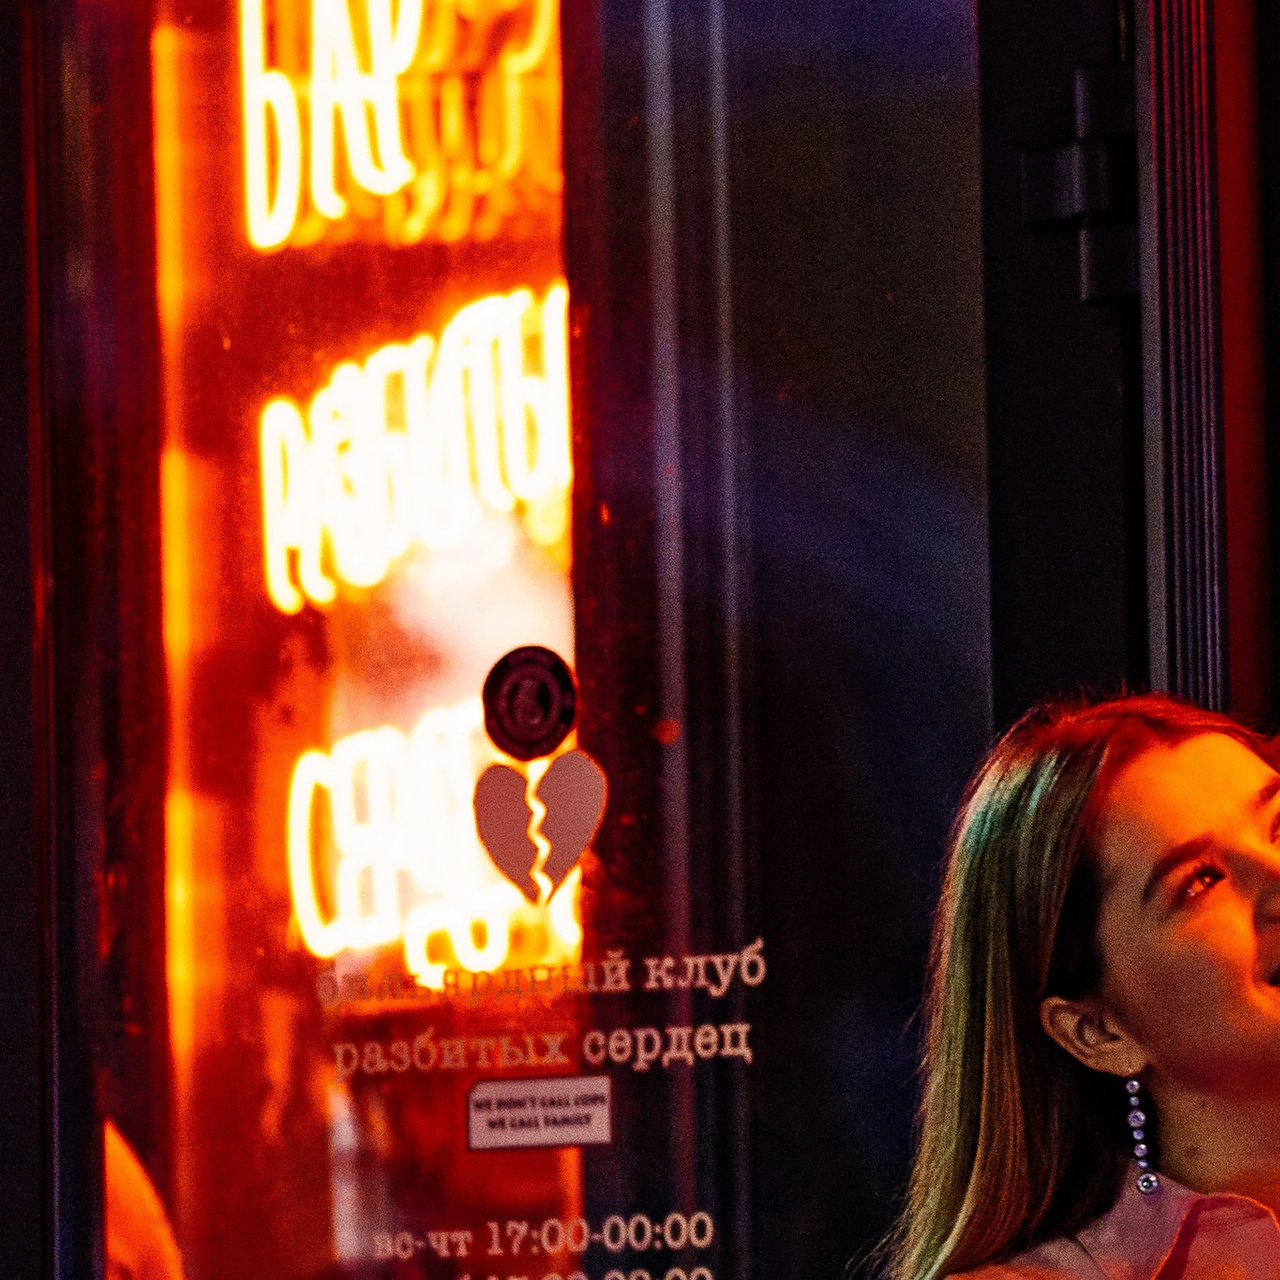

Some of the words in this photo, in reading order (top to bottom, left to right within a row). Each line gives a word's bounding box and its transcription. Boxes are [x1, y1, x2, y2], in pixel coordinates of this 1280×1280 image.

[260, 282, 572, 614] РАЗБИТЫ
[643, 936, 767, 998] клуб
[332, 1025, 571, 1083] разбитых
[582, 1021, 754, 1071] сердец
[486, 1211, 714, 1258] 17:00-00:00
